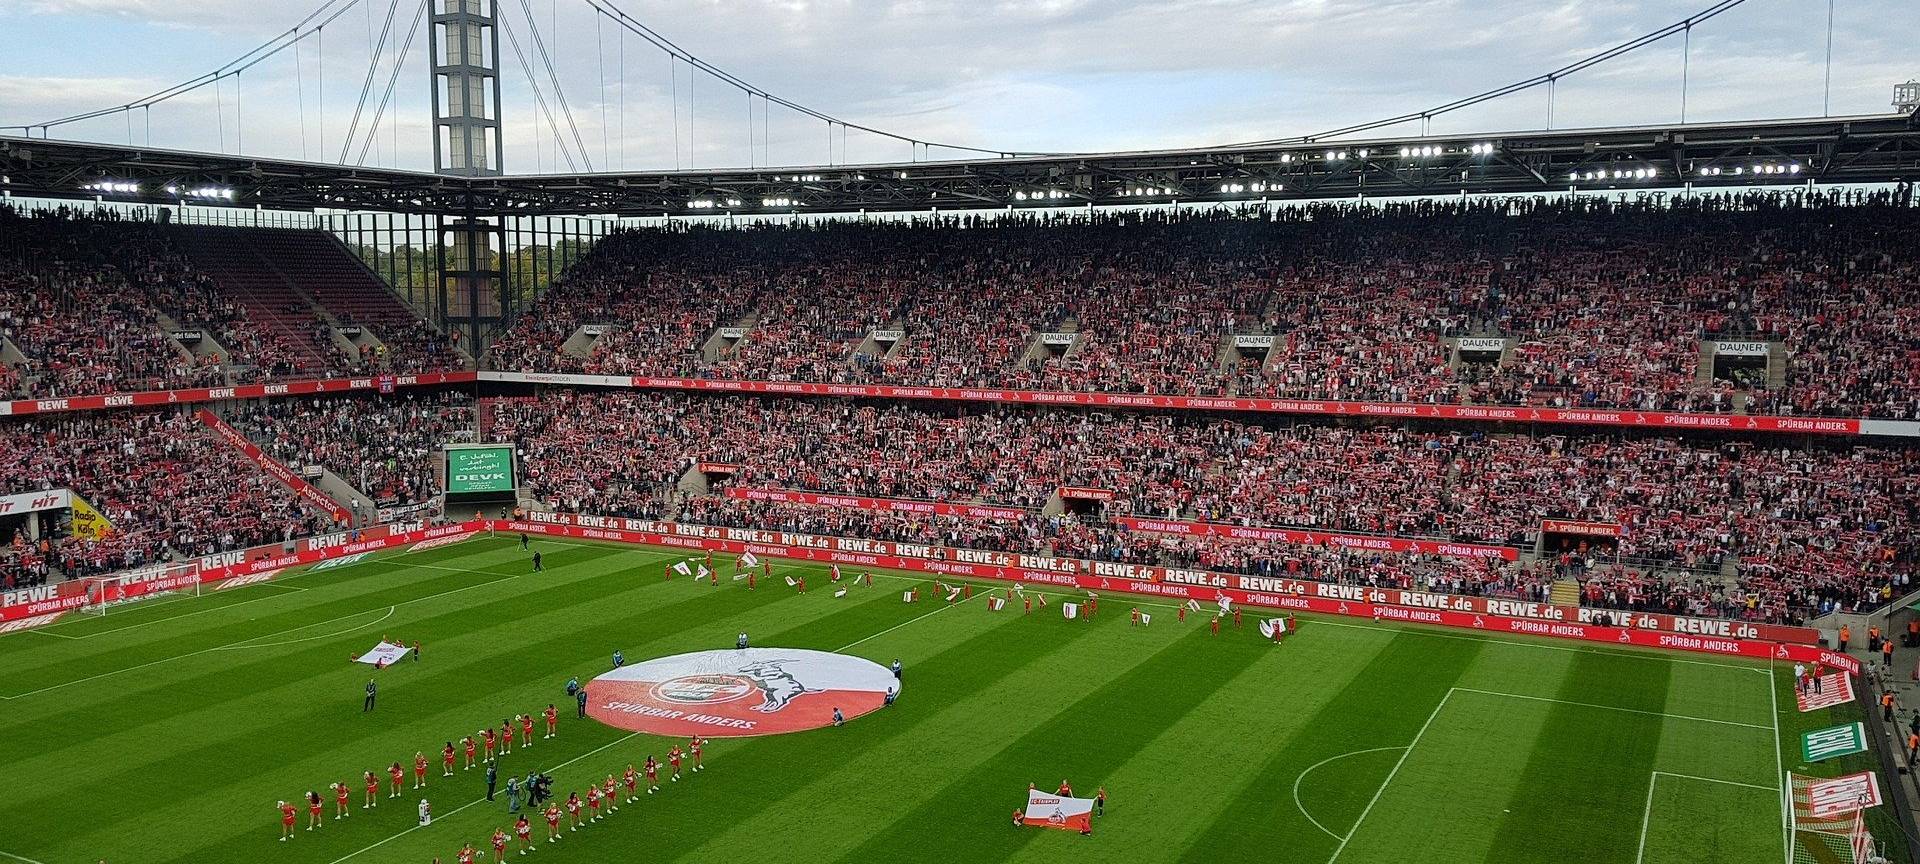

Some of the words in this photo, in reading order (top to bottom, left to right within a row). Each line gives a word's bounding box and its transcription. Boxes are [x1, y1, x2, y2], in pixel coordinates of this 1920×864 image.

[1045, 333, 1074, 341] DAUNER
[1238, 336, 1272, 344] DAUNER
[1462, 339, 1500, 347] DAUNER
[1720, 343, 1763, 352] DAUNER
[350, 379, 371, 388] REWE
[396, 376, 417, 385] REWE
[209, 388, 235, 398] REWE
[264, 384, 288, 394] REWE
[37, 399, 69, 411] REWE
[104, 395, 133, 406] REWE
[1186, 398, 1213, 408] SPÜRBAR
[1271, 401, 1299, 410] SPÜRBAR
[1360, 403, 1390, 413] SPÜRBAR
[1391, 406, 1418, 415] ANDERS.
[1456, 407, 1487, 417] SPÜRBAR
[1488, 409, 1517, 418] ANDERS.
[1557, 410, 1590, 421] SPÜRBAR
[1591, 413, 1622, 422] ANDERS.
[1664, 414, 1699, 425] SPÜRBAR
[1701, 416, 1732, 426] ANDERS.
[1777, 418, 1813, 430] SPÜRBAR
[1815, 420, 1849, 431] ANDERS.
[214, 420, 248, 450] Aspecton
[257, 453, 292, 483] Aspecton
[455, 472, 505, 481] DEVK
[31, 496, 59, 509] HIT
[302, 485, 339, 513] Aspecton
[0, 502, 14, 513] IT
[74, 509, 97, 522] Radio
[530, 511, 570, 525] REWE.de
[577, 514, 618, 529] REWE.de
[77, 524, 96, 536] Köln
[389, 520, 424, 536] REWE
[424, 527, 445, 538] SPÜRBAR
[445, 525, 464, 535] ANDERS.
[625, 518, 668, 534] REWE.de
[675, 524, 720, 539] REWE.de
[1137, 519, 1165, 530] SPÜRBAR
[1165, 522, 1191, 533] ANDERS.
[1230, 528, 1260, 538] SPÜRBAR
[1559, 523, 1589, 534] SPÜRBAR
[1590, 525, 1616, 536] ANDERS.
[308, 533, 347, 551] REWE
[661, 535, 683, 546] SPÜRBAR
[683, 538, 703, 547] ANDERS.
[728, 528, 773, 544] REWE.de
[1330, 536, 1362, 547] SPÜRBAR
[1363, 539, 1392, 549] ANDERS.
[342, 543, 365, 554] SPÜRBAR
[365, 539, 387, 550] ANDERS.
[743, 544, 766, 554] SPÜRBAR
[766, 546, 789, 556] ANDERS.
[837, 538, 886, 554] REWE.de
[1437, 544, 1472, 556] SPÜRBAR
[201, 551, 245, 571] REWE
[251, 560, 277, 572] SPÜRBAR
[277, 555, 300, 567] ANDERS.
[831, 552, 855, 562] SPÜRBAR
[855, 555, 879, 565] ANDERS.
[957, 550, 1008, 566] REWE.de
[1019, 555, 1075, 572] REWE.de
[924, 560, 950, 571] SPÜRBAR
[951, 564, 975, 574] ANDERS.
[1095, 562, 1153, 580] REWE.de
[146, 578, 176, 592] SPÜRBAR
[1023, 571, 1051, 581] SPÜRBAR
[1051, 574, 1078, 585] ANDERS.
[1165, 569, 1227, 587] REWE.de
[3, 584, 58, 608] REWE
[1130, 582, 1160, 593] SPÜRBAR
[1161, 584, 1190, 596] ANDERS.
[1317, 583, 1386, 603] REWEde
[28, 598, 61, 614] SPÜRBAR
[1246, 593, 1279, 605] SPÜRBAR
[1280, 597, 1310, 609] ANDERS.
[1400, 591, 1472, 611] REWE.de
[1373, 606, 1409, 619] SPÜRBAR
[1410, 610, 1442, 623] ANDERS.
[1487, 600, 1563, 621] REWE.de
[1510, 619, 1549, 633] SPÜRBAR
[1551, 624, 1586, 638] ANDERS.
[1674, 617, 1758, 639] REWE.de
[1659, 635, 1701, 648] SPÜRBAR
[1703, 640, 1741, 653] ANDERS.
[603, 701, 684, 720] SPÜRBAR
[681, 713, 757, 730] ANDERS.
